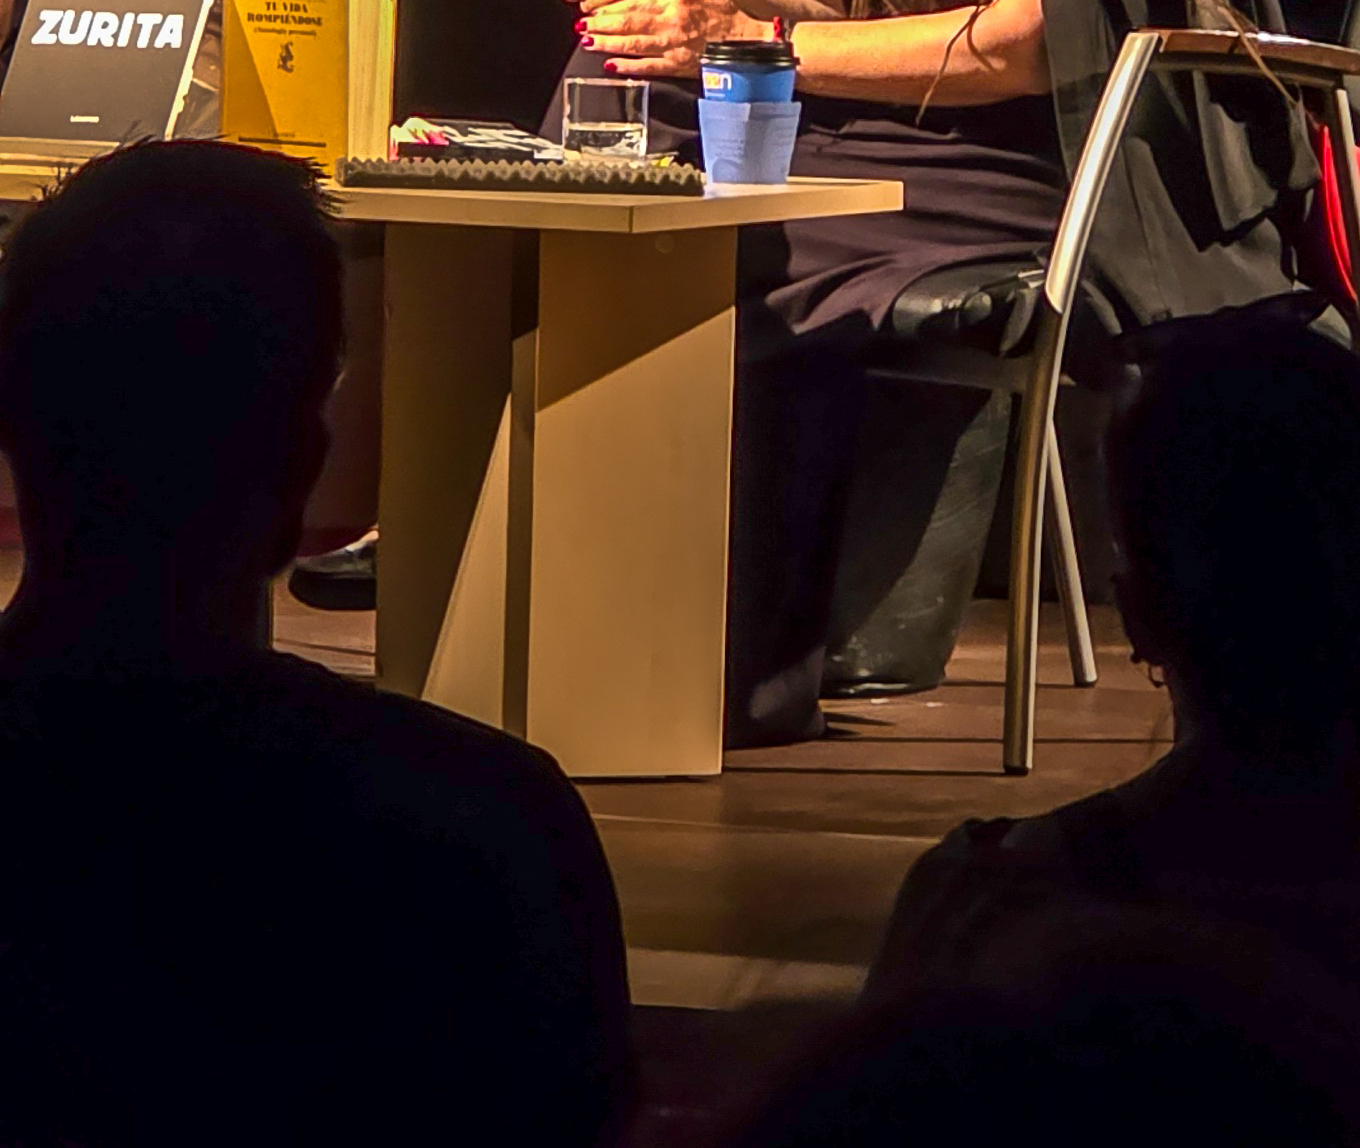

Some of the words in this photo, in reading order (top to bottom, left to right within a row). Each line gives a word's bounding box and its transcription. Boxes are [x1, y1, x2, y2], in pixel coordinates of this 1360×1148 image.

[265, 1, 277, 11] TU
[282, 2, 309, 13] VIDA
[31, 9, 184, 48] ZURITA
